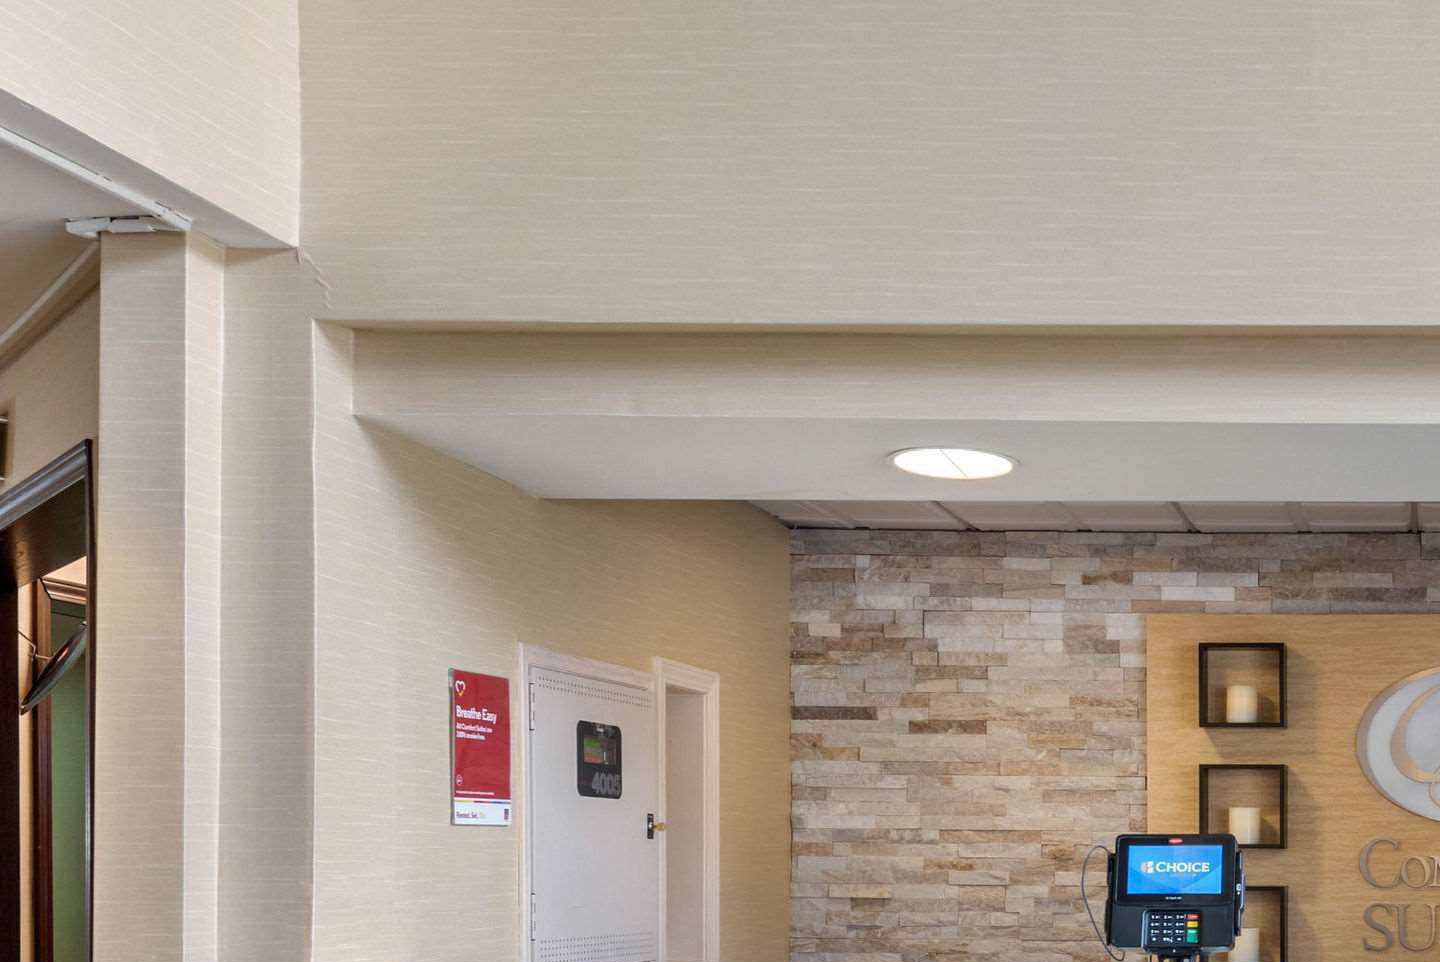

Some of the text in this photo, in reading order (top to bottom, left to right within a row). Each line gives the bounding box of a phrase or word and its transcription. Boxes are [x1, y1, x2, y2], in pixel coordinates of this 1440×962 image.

[456, 705, 497, 724] Breathe Easy
[592, 771, 621, 796] 4005
[1155, 861, 1211, 873] CHOICE
